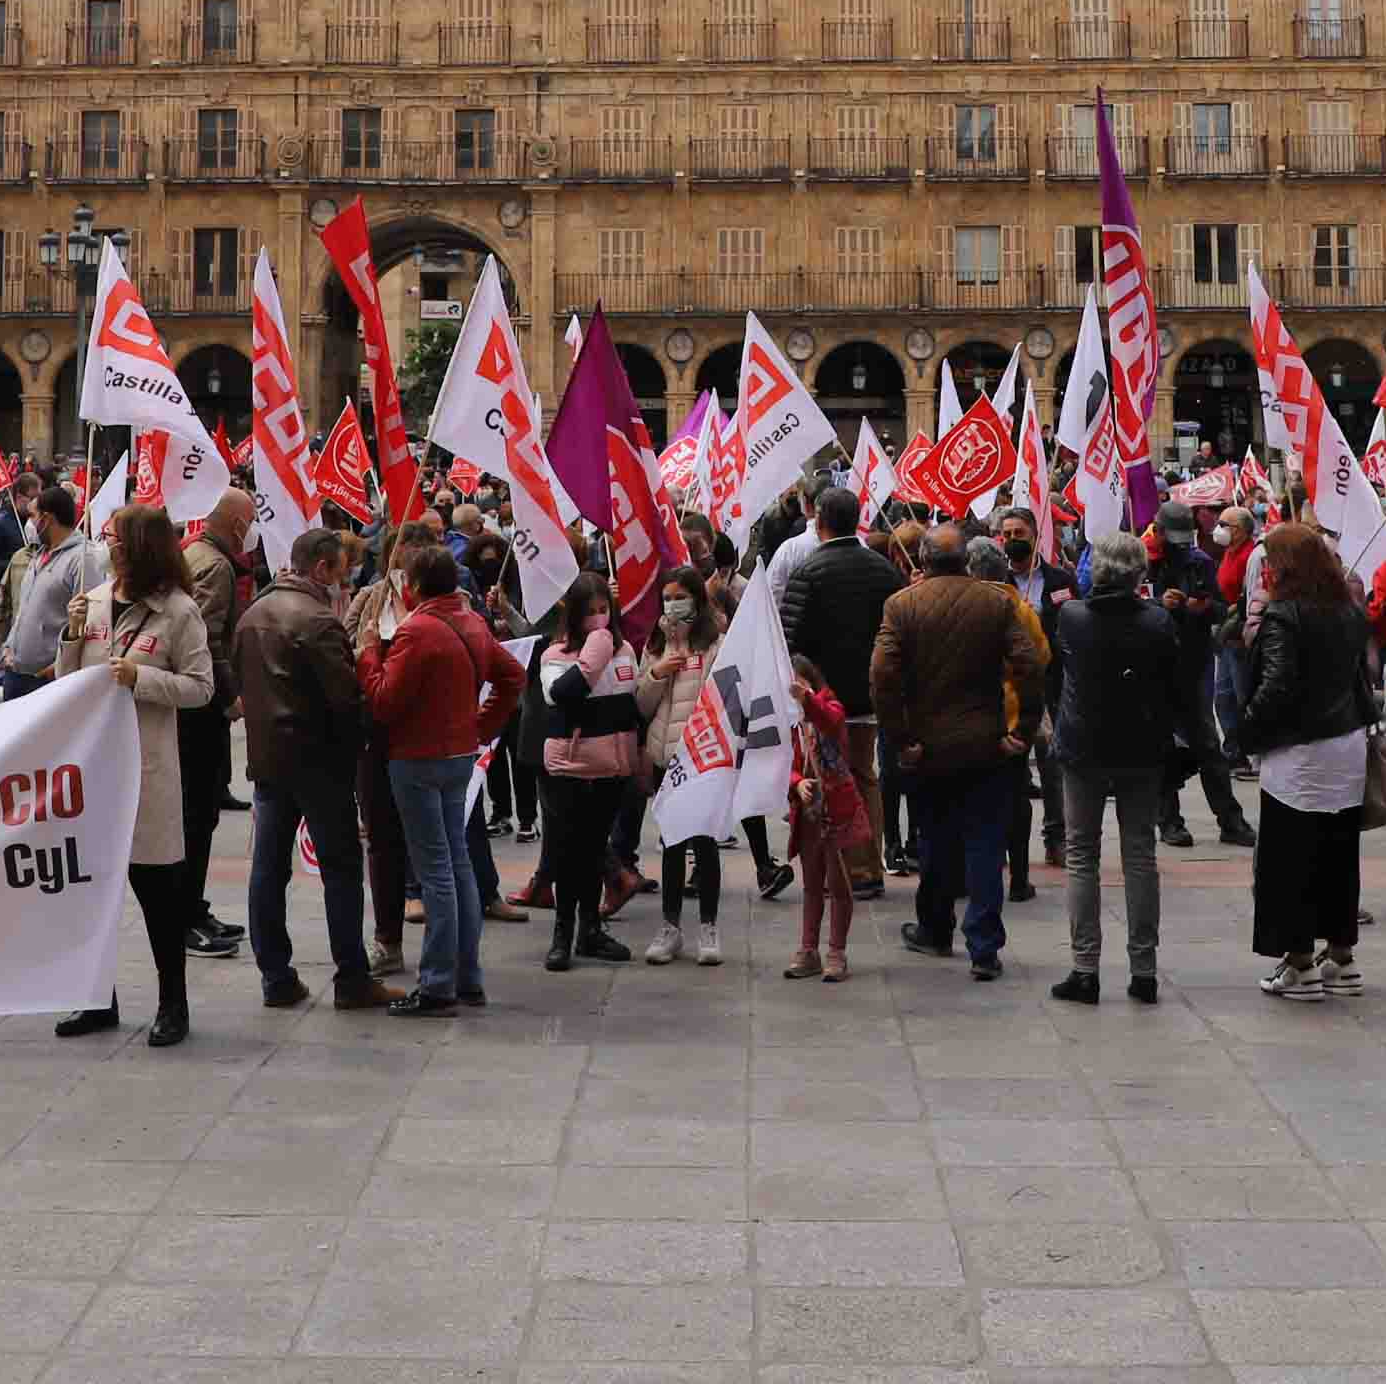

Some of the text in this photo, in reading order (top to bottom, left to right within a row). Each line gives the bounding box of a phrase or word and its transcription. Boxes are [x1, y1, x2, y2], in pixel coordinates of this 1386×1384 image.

[104, 365, 184, 405] Castilla
[944, 422, 989, 478] UGT
[3, 836, 92, 895] CyL
